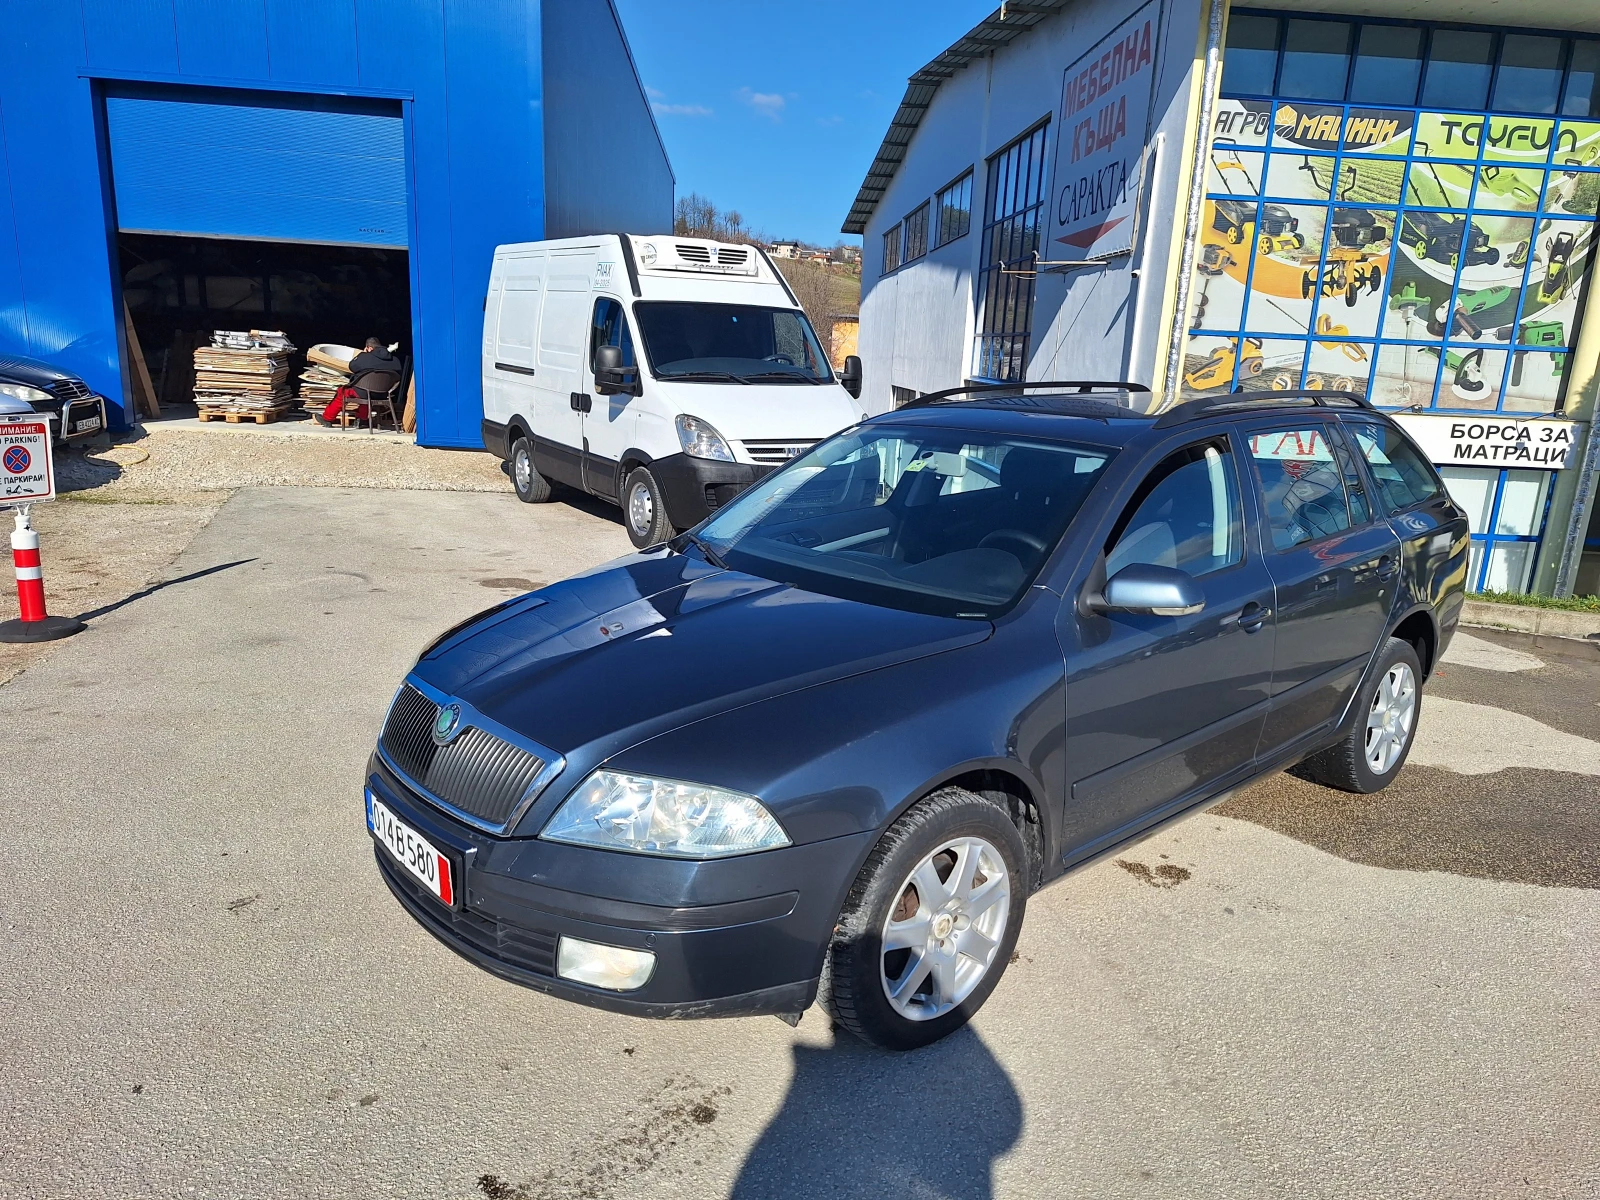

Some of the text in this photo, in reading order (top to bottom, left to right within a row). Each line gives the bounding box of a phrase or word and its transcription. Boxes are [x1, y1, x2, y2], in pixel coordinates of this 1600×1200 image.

[1064, 19, 1151, 121] МЕБЕЛНА
[1070, 94, 1127, 165] КЪЩА
[1213, 110, 1400, 145] АГРО МАШИНИ
[1058, 157, 1128, 227] САРАКТА
[0, 425, 39, 435] ИМАНИЕ!
[4, 436, 41, 445] PARKING!
[1450, 423, 1570, 443] БОРСА ЗА
[1453, 443, 1567, 465] МАТРАЦИ
[4, 474, 45, 485] ПАРКИРАЙ!
